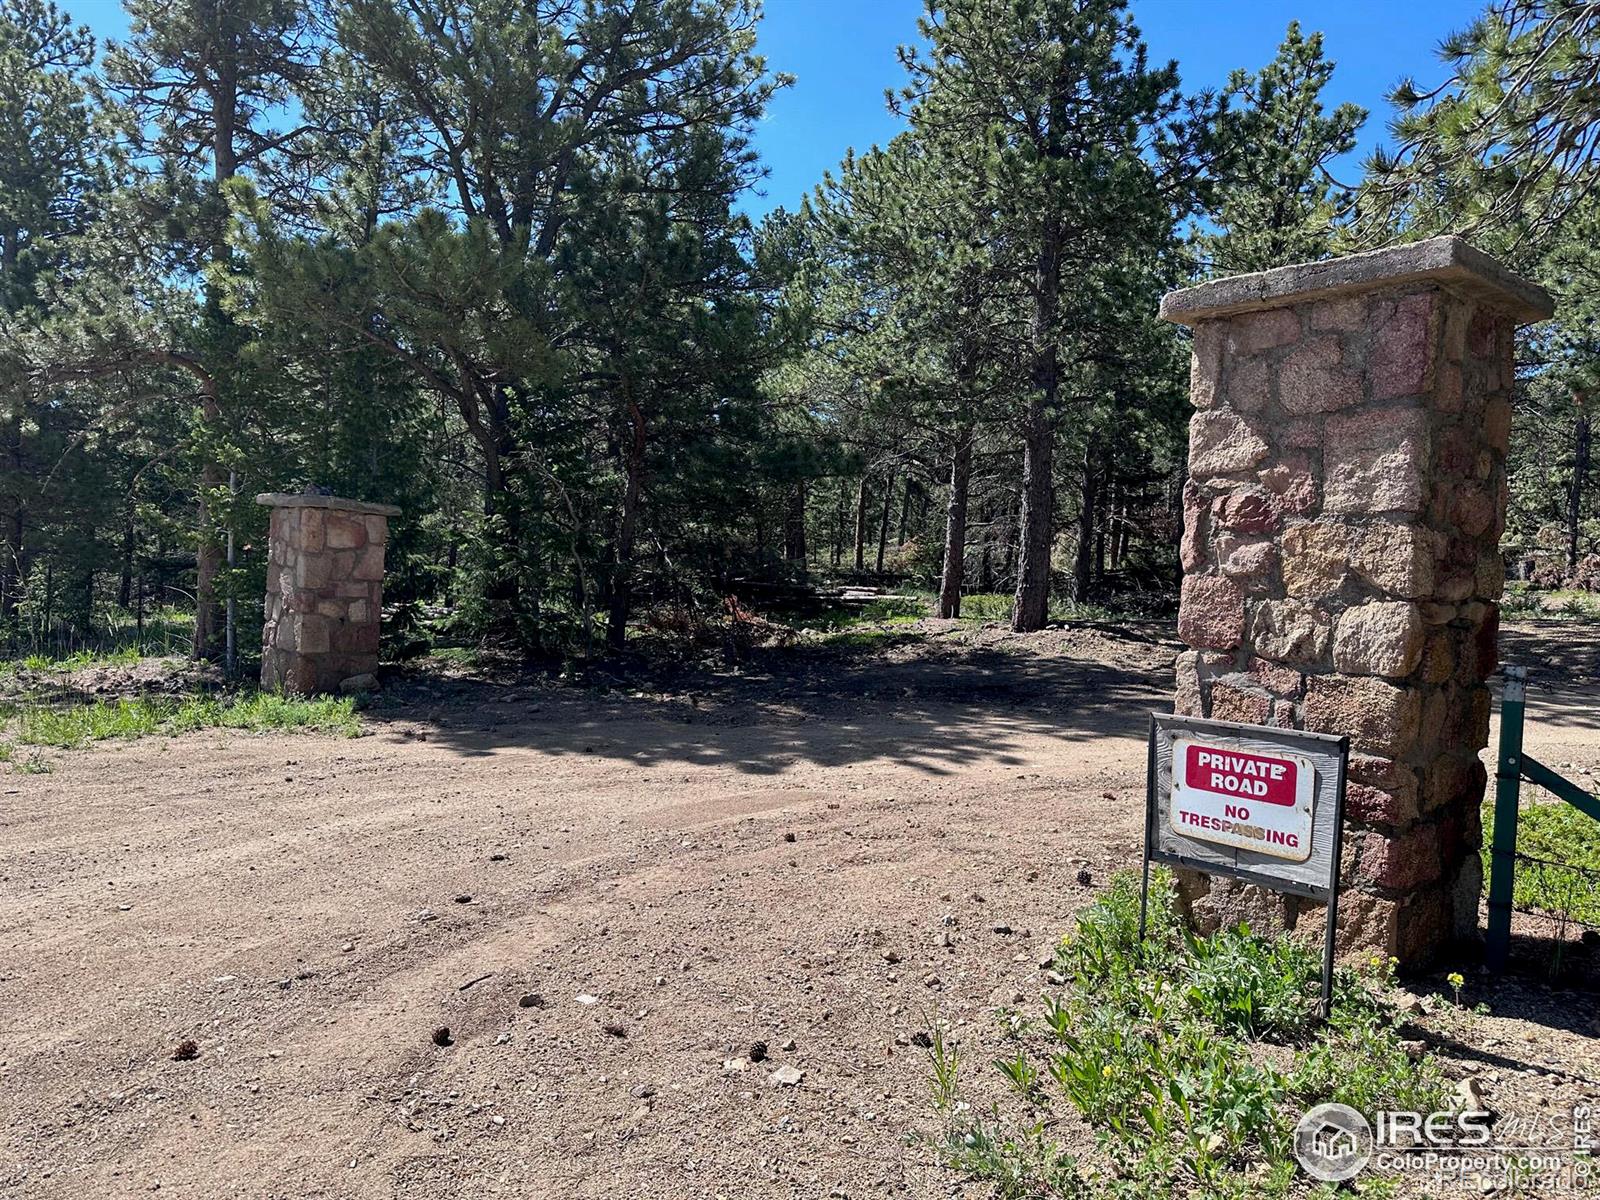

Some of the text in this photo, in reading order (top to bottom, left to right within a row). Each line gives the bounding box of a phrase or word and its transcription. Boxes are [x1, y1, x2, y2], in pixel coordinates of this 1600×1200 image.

[1198, 752, 1287, 780] PRIVATE
[1211, 773, 1268, 796] ROAD
[1224, 804, 1250, 820] NO
